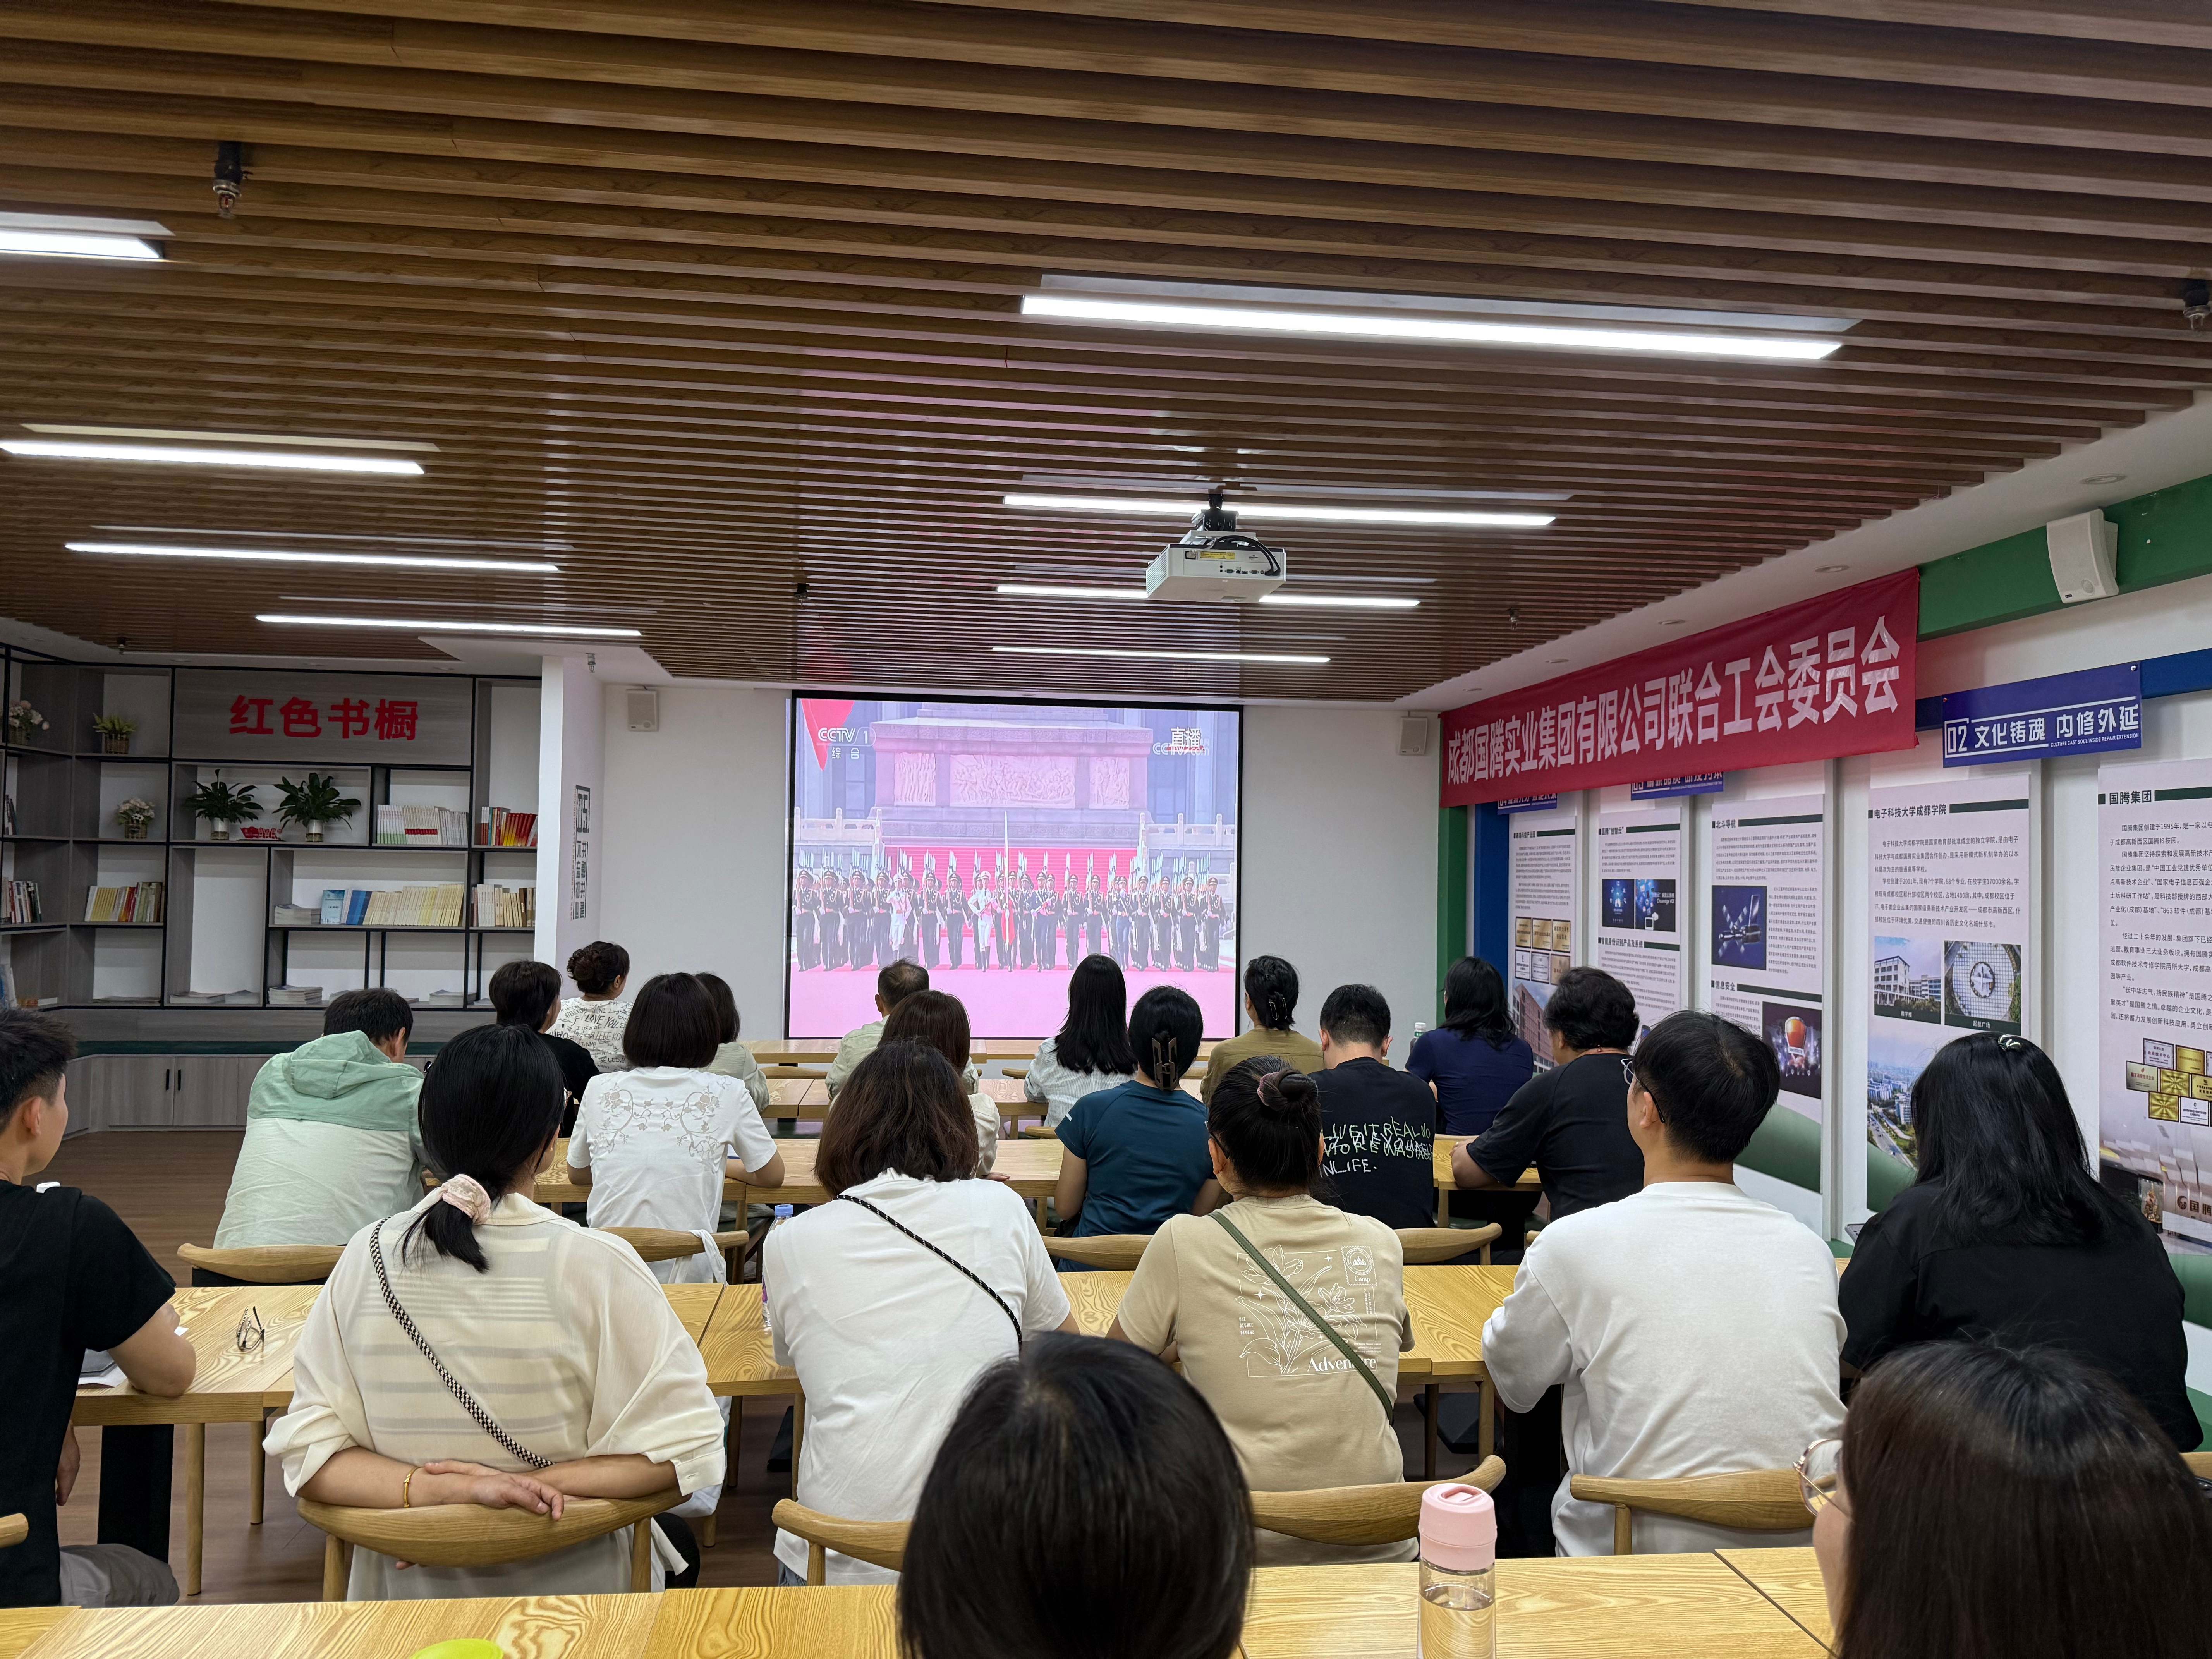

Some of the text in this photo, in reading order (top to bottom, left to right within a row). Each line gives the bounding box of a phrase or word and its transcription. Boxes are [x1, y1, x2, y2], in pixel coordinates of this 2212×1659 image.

[1448, 615, 1901, 785] 成都国腾实业集团有限公司联合工会委员会
[229, 695, 419, 740] 红色书橱
[818, 727, 856, 742] CCTV
[1170, 726, 1201, 748] 直播
[1947, 704, 2139, 754] 02 文化铸魂 内修外延
[832, 747, 860, 759] 综合
[2109, 790, 2152, 805] 国腾集团
[1874, 803, 1947, 819] 电子科技大学成都学院
[2110, 878, 2212, 886] 点高新技术企业”、“国家电子信息百强企
[2110, 959, 2212, 973] 成都软件技术专修学院两所大学，成都高
[1383, 1116, 1420, 1140] REAL
[1420, 1123, 1431, 1139] NO
[1307, 1356, 1376, 1372] Advenre
